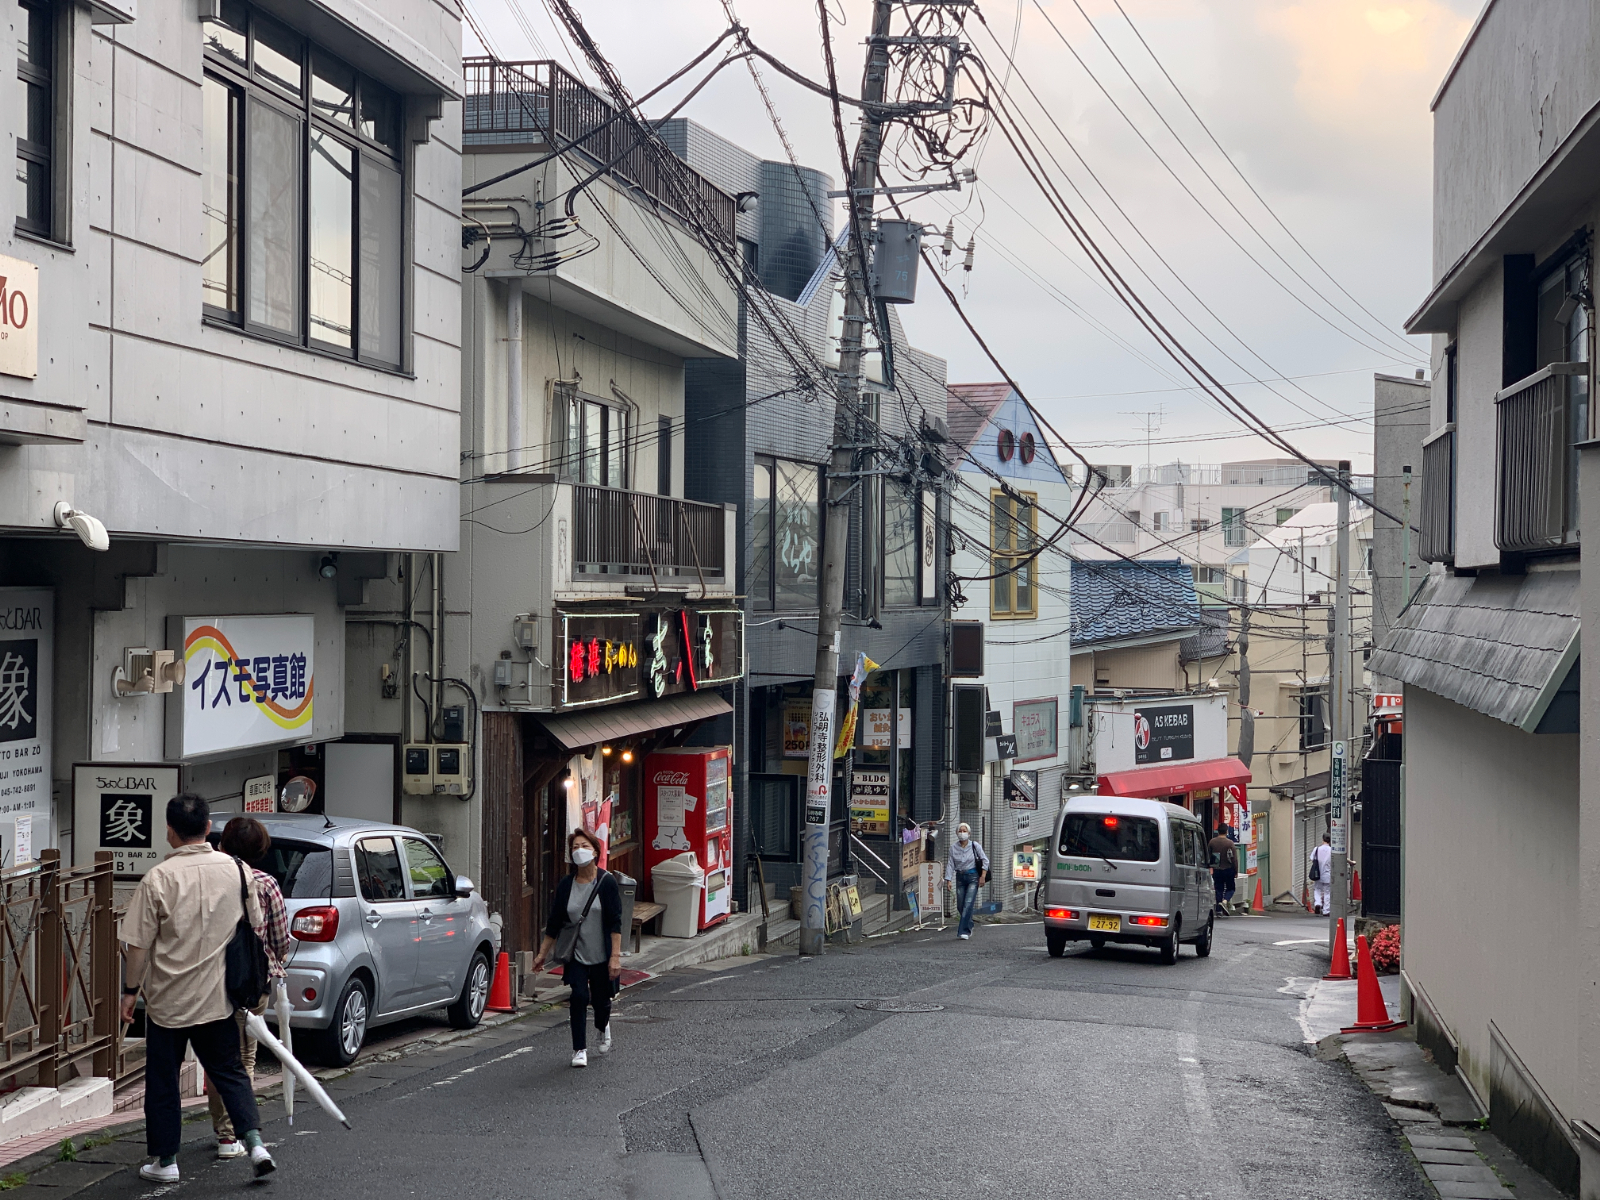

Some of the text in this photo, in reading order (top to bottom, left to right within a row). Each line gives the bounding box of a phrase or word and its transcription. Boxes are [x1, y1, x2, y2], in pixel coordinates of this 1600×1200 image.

[895, 270, 908, 281] 75
[192, 652, 306, 710] イズモ写真館
[0, 651, 32, 730] 象
[1154, 714, 1188, 728] AS KEBAB
[15, 748, 28, 758] BAR
[815, 711, 829, 783] 弘明寺整形外科
[13, 766, 43, 777] YOKOHAMA
[653, 771, 690, 785] Coca-Cola
[1332, 777, 1341, 817] 清水眼科
[105, 800, 146, 842] 象
[1241, 810, 1250, 831] すが
[1096, 920, 1119, 930] 27-92
